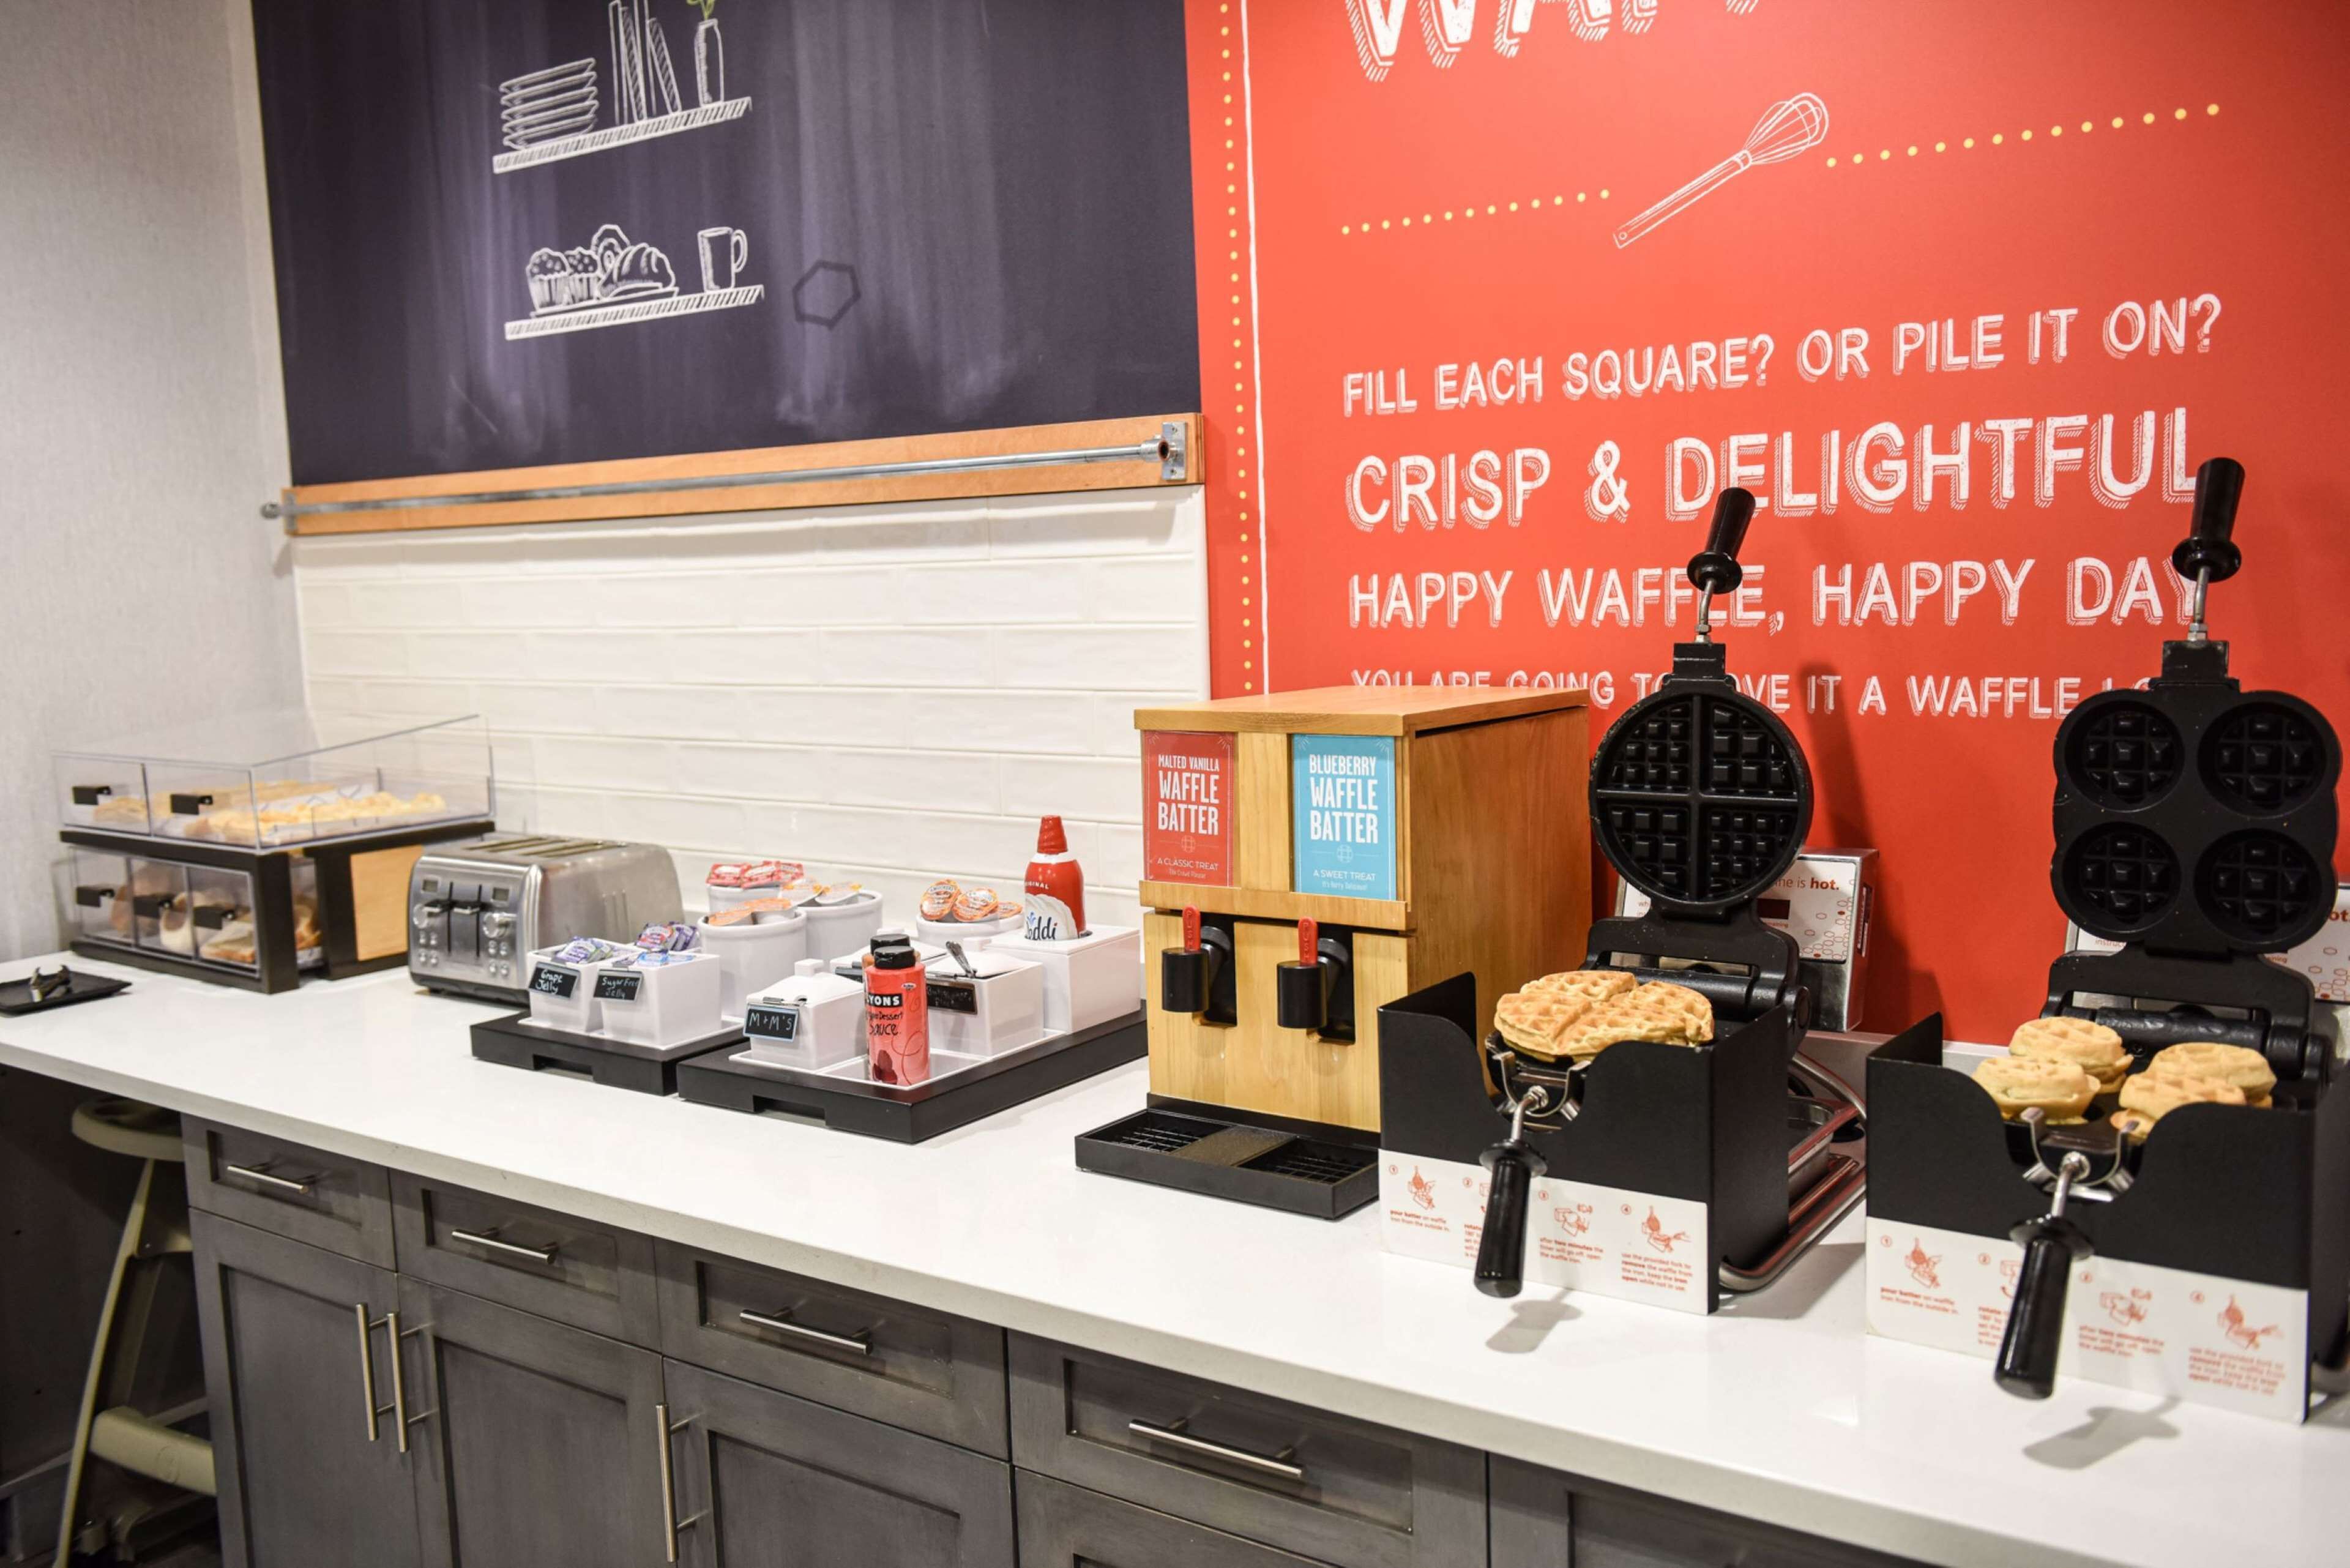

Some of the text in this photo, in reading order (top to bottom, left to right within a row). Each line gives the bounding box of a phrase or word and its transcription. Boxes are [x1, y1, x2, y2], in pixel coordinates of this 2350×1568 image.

[1343, 293, 2222, 417] FILL EACH SQUARE? OR PILE IT ON?
[1346, 407, 2197, 534] CRISP & DELIGHTFUL
[1348, 569, 1514, 629] HAPPY
[1813, 558, 2035, 627] HAPPY
[1725, 673, 1790, 712] VE
[1807, 675, 1842, 714] IT
[1858, 675, 1887, 715] A
[1906, 675, 2081, 719] WAFFLE
[1158, 753, 1220, 772] MALTED VANILLA
[1309, 753, 1376, 777] BLUEBERRY
[1158, 770, 1220, 804] WAFFLE
[1310, 776, 1379, 811] WAFFLE
[1158, 801, 1219, 835] BATTER
[1310, 809, 1379, 844] BATTER
[1164, 857, 1194, 868] CLASSIC
[1195, 861, 1219, 871] TREAT
[1321, 869, 1348, 879] SWEET
[1350, 871, 1376, 881] TREAT
[1797, 876, 1806, 888] is
[1810, 877, 1840, 890] hot.
[1024, 916, 1058, 941] eddi
[2328, 909, 2350, 922] ot
[867, 995, 900, 1006] YONS
